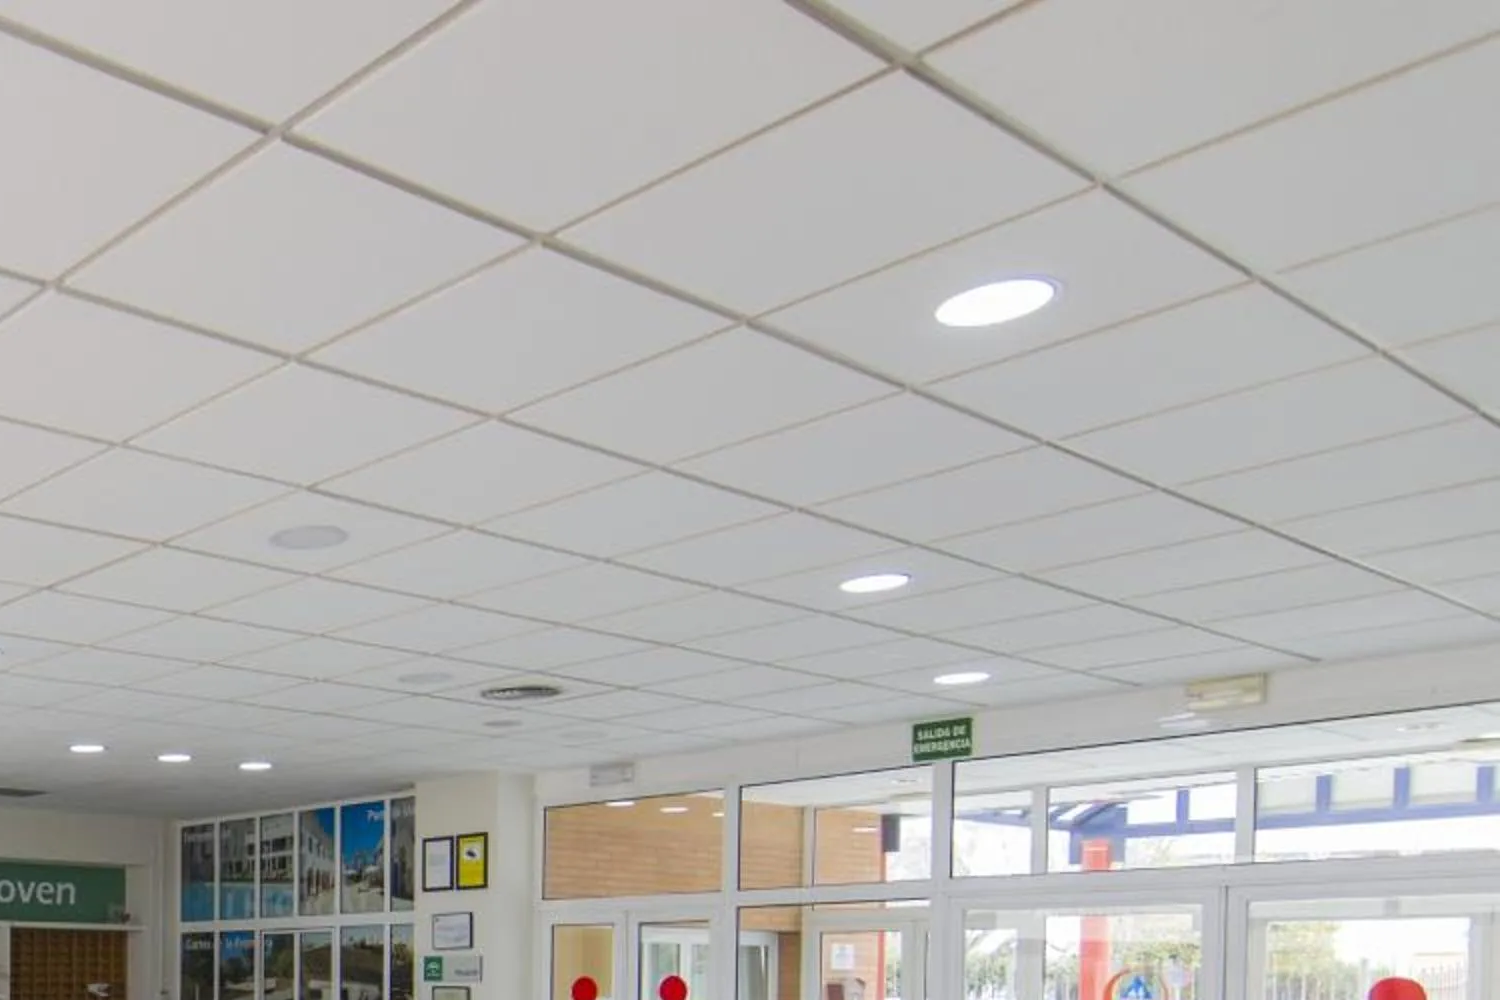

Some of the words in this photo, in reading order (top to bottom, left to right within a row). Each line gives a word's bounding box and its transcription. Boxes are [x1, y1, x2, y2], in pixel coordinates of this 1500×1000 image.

[916, 727, 951, 740] SALIDA
[953, 725, 967, 737] DE
[913, 738, 971, 753] EMERGENCIA
